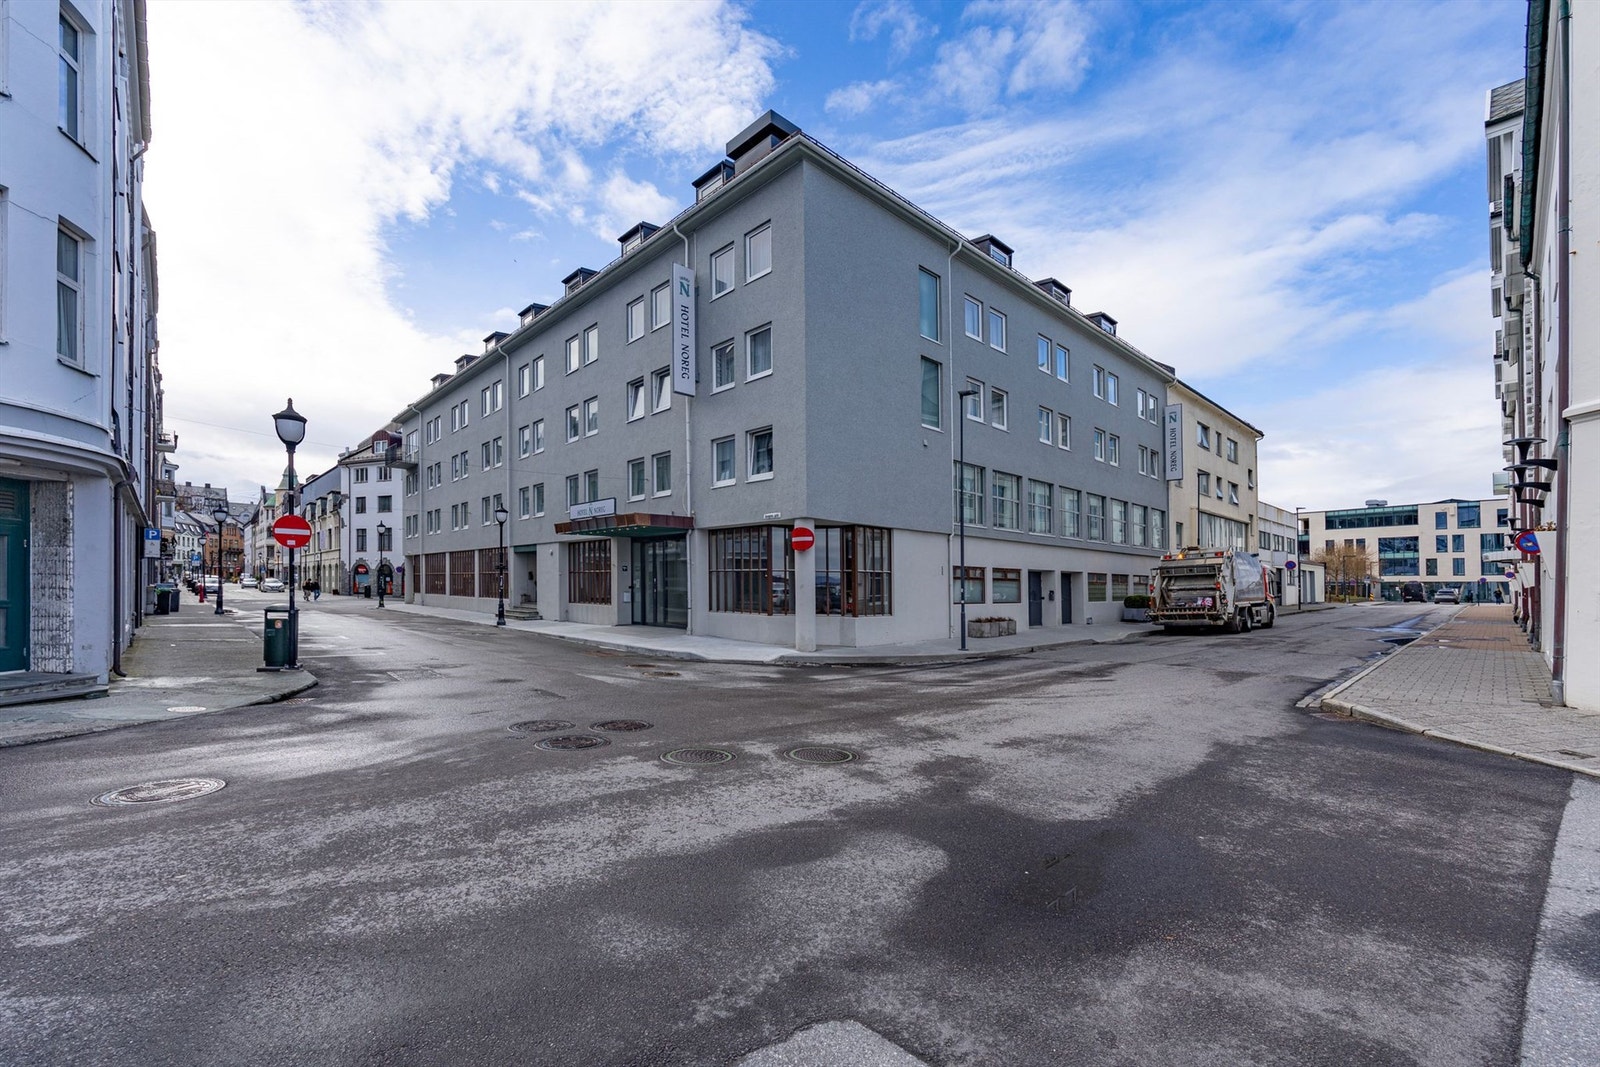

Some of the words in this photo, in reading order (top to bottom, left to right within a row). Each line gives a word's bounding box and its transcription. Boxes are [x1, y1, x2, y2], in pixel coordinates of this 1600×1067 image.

[680, 304, 690, 339] HOTEL
[681, 344, 690, 380] NOREG
[1169, 428, 1177, 449] HOTEL
[149, 530, 157, 539] P
